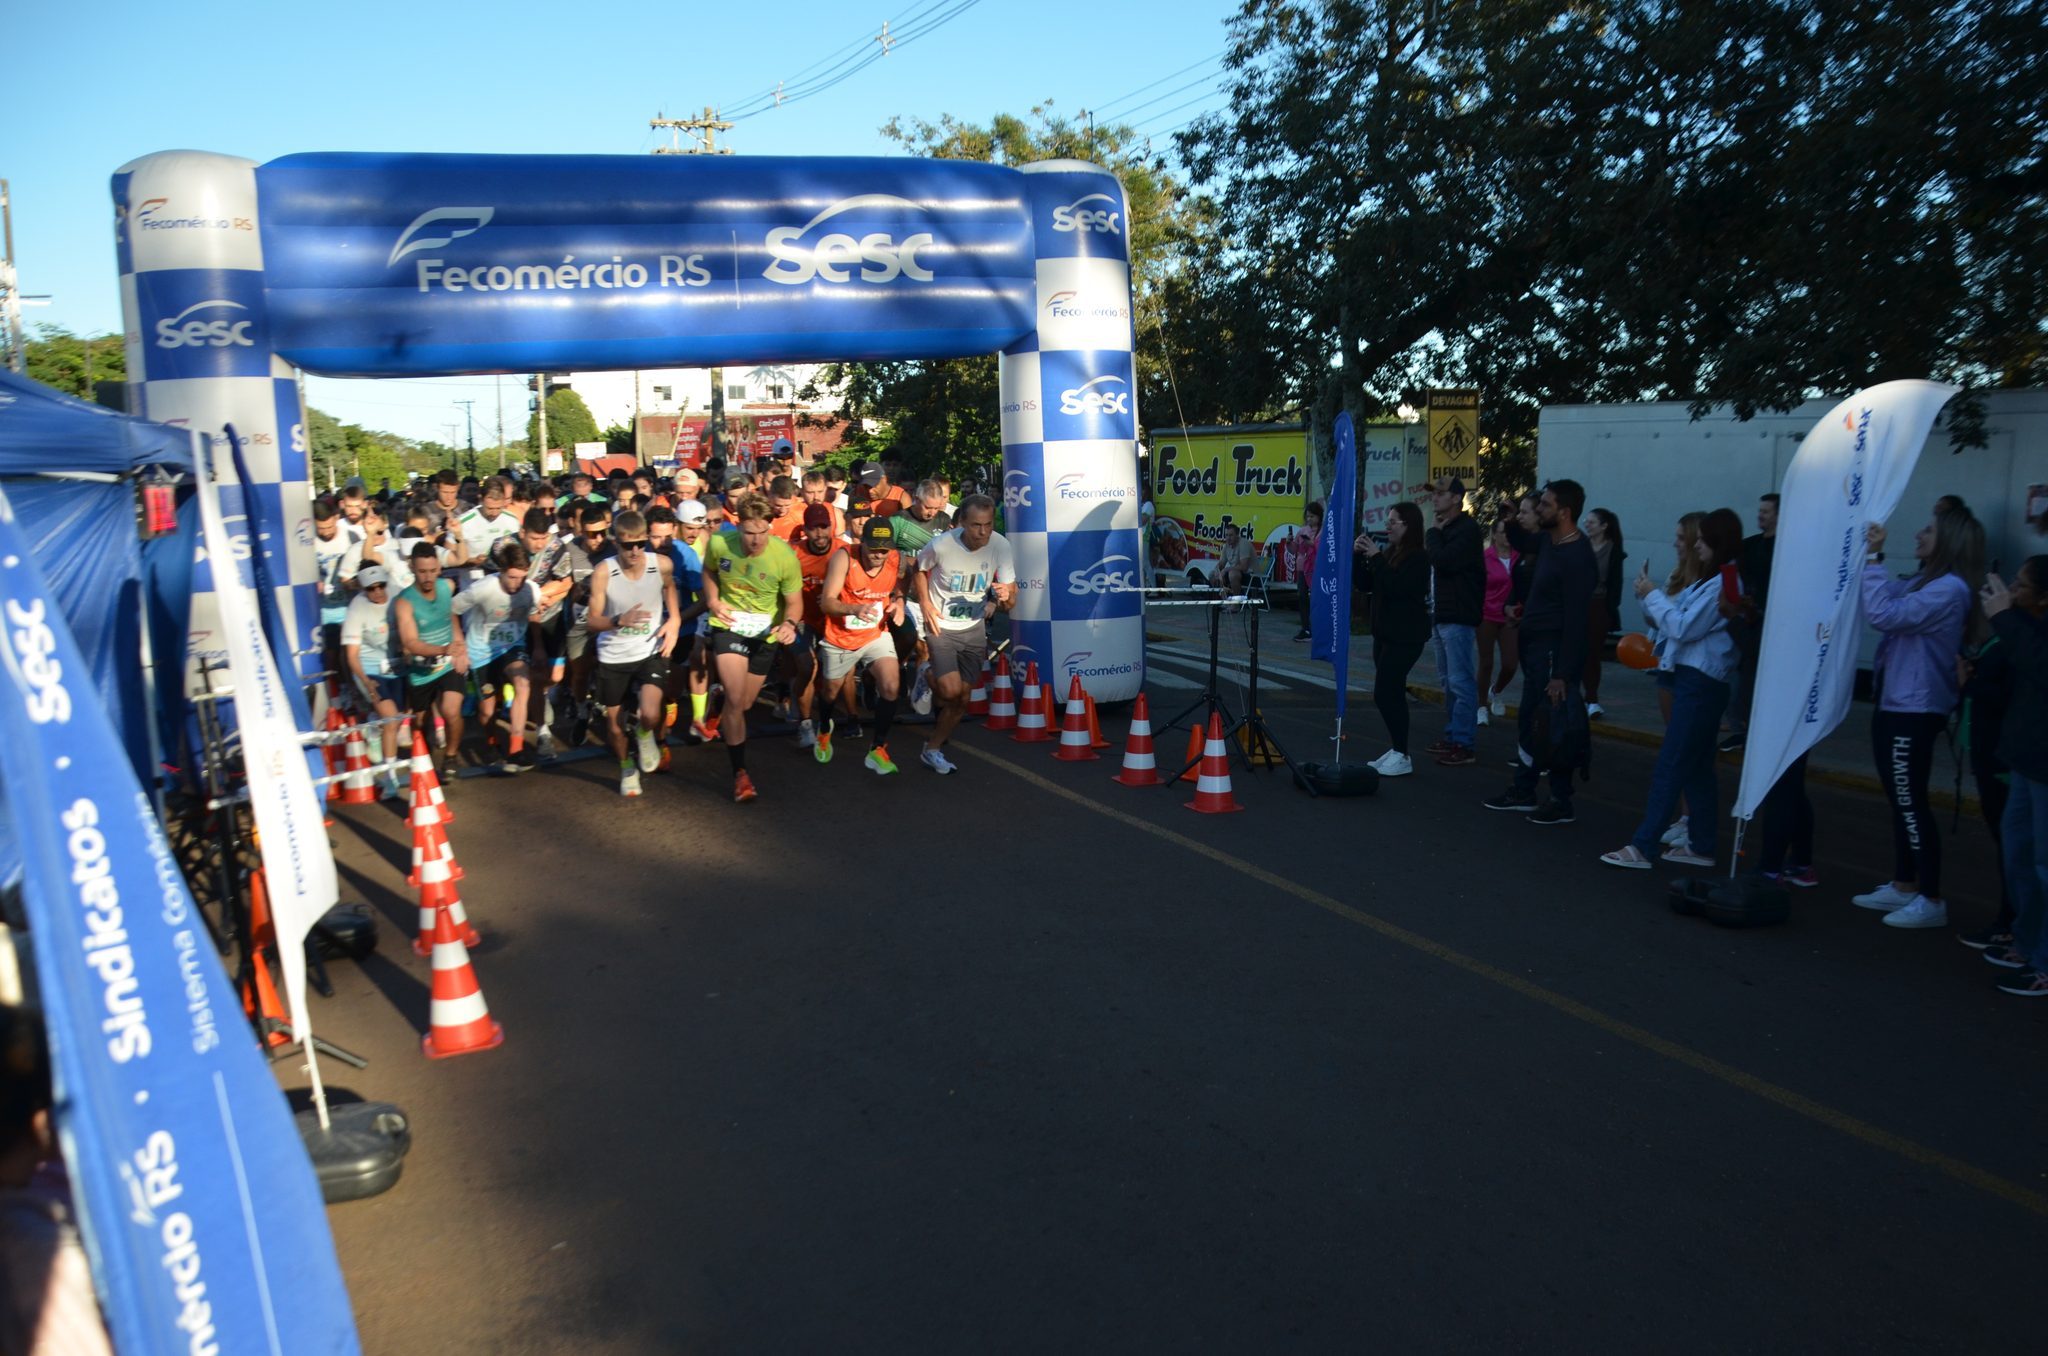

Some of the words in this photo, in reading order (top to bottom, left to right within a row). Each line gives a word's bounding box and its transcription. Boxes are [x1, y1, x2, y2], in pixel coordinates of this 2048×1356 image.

[234, 218, 253, 231] RS
[416, 255, 648, 292] Fecomércio
[659, 254, 711, 288] RS
[1023, 400, 1037, 412] RS
[1432, 395, 1476, 406] DEVAGAR
[1157, 445, 1218, 496] Food
[1232, 443, 1303, 496] Truck
[1127, 486, 1136, 497] RS
[1327, 510, 1337, 563] Sindicatos
[1030, 579, 1045, 590] RS
[1329, 577, 1337, 592] RS
[1892, 736, 1912, 806] GROWTH
[1902, 811, 1920, 850] TEAM
[61, 797, 152, 1064] Sindicatos
[172, 929, 220, 1055] Sistema
[133, 1130, 184, 1208] RS
